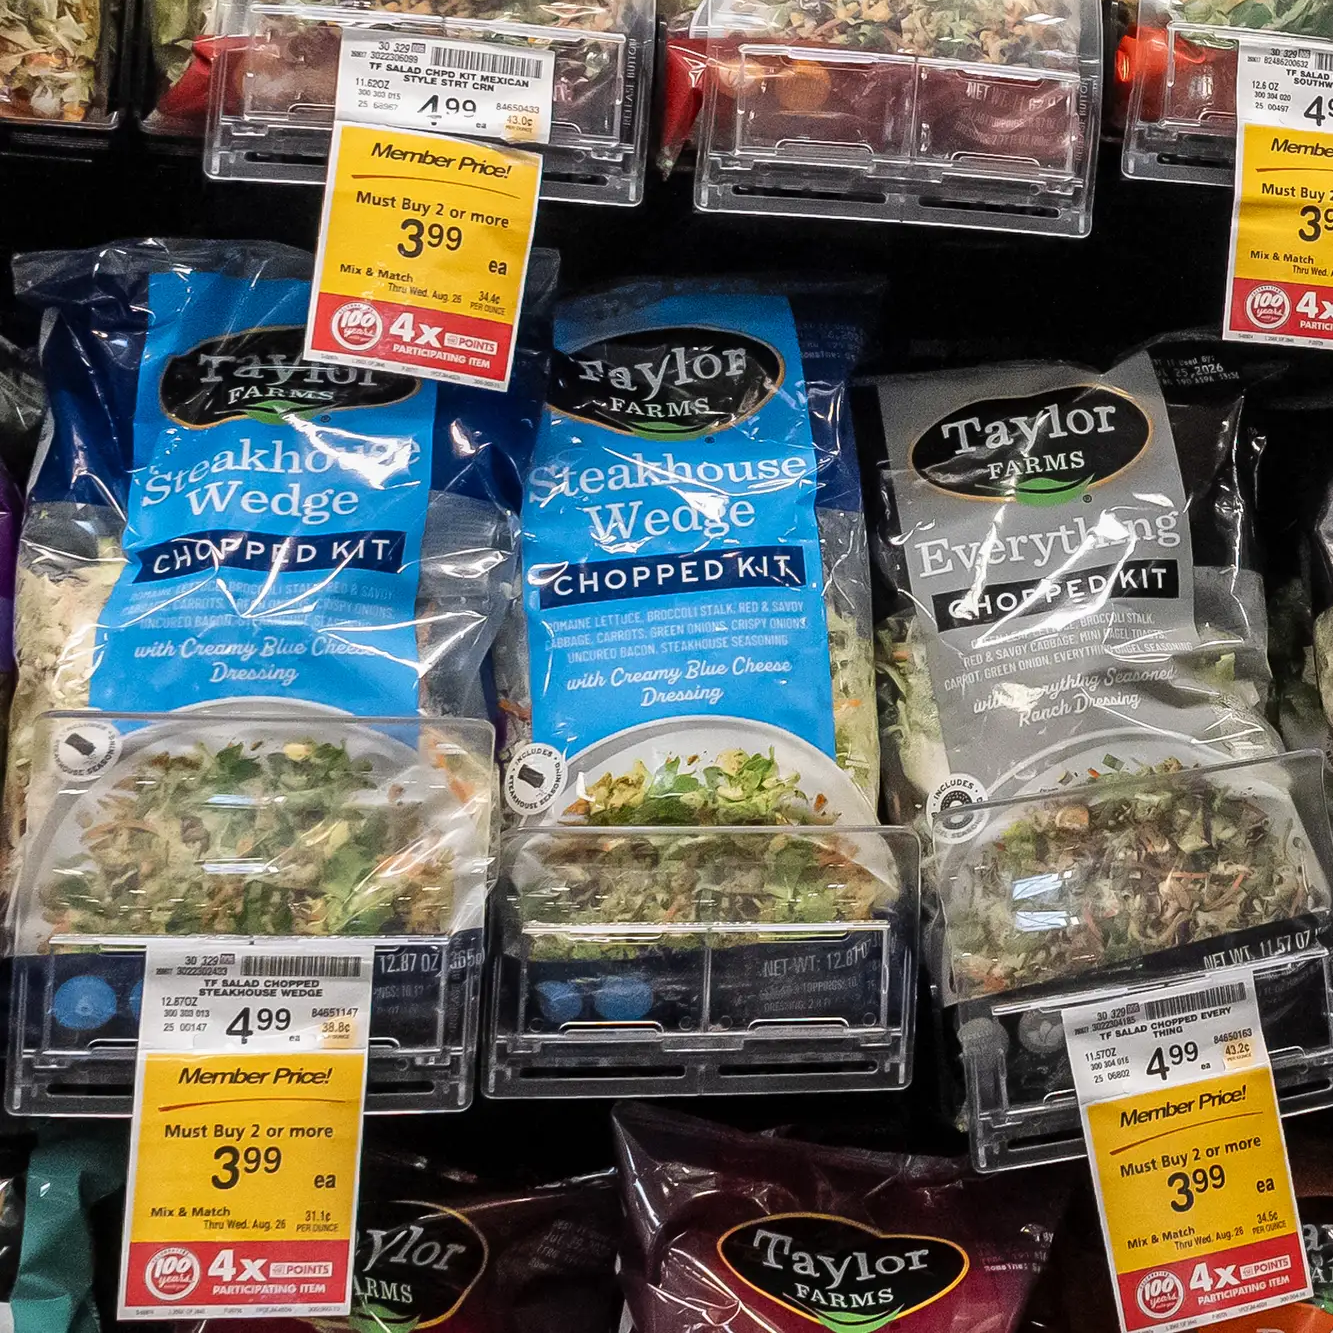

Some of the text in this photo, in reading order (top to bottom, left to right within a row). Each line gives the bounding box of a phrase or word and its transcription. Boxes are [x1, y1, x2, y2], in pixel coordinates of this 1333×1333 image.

[369, 62, 529, 88] TF SALAD CHPD KIT MEXICAN
[403, 74, 494, 92] STYLE STRT CRN
[1252, 81, 1279, 91] 12.6 OZ
[356, 190, 509, 229] Must Buy 2 or more
[579, 346, 748, 402] Taylor
[228, 385, 335, 404] FARMS
[610, 396, 711, 419] FARMS
[941, 404, 1117, 457] Taylor
[528, 451, 807, 506] Steakhouse
[987, 450, 1086, 481] FARMS
[187, 481, 359, 524] Wedge
[554, 555, 792, 597] CHOPPED KIT
[567, 656, 792, 694] with Creamy Blue Cheese
[641, 684, 724, 708] Dressing
[1019, 692, 1141, 727] Ranch Dressing
[931, 778, 975, 805] INCLUDES
[199, 988, 323, 998] STEAKHOUSE WEDGE
[1213, 1027, 1253, 1045] 84650163
[305, 1210, 331, 1222] 31.1¢
[752, 1229, 929, 1290] Taylor
[795, 1282, 894, 1308] FARMS
